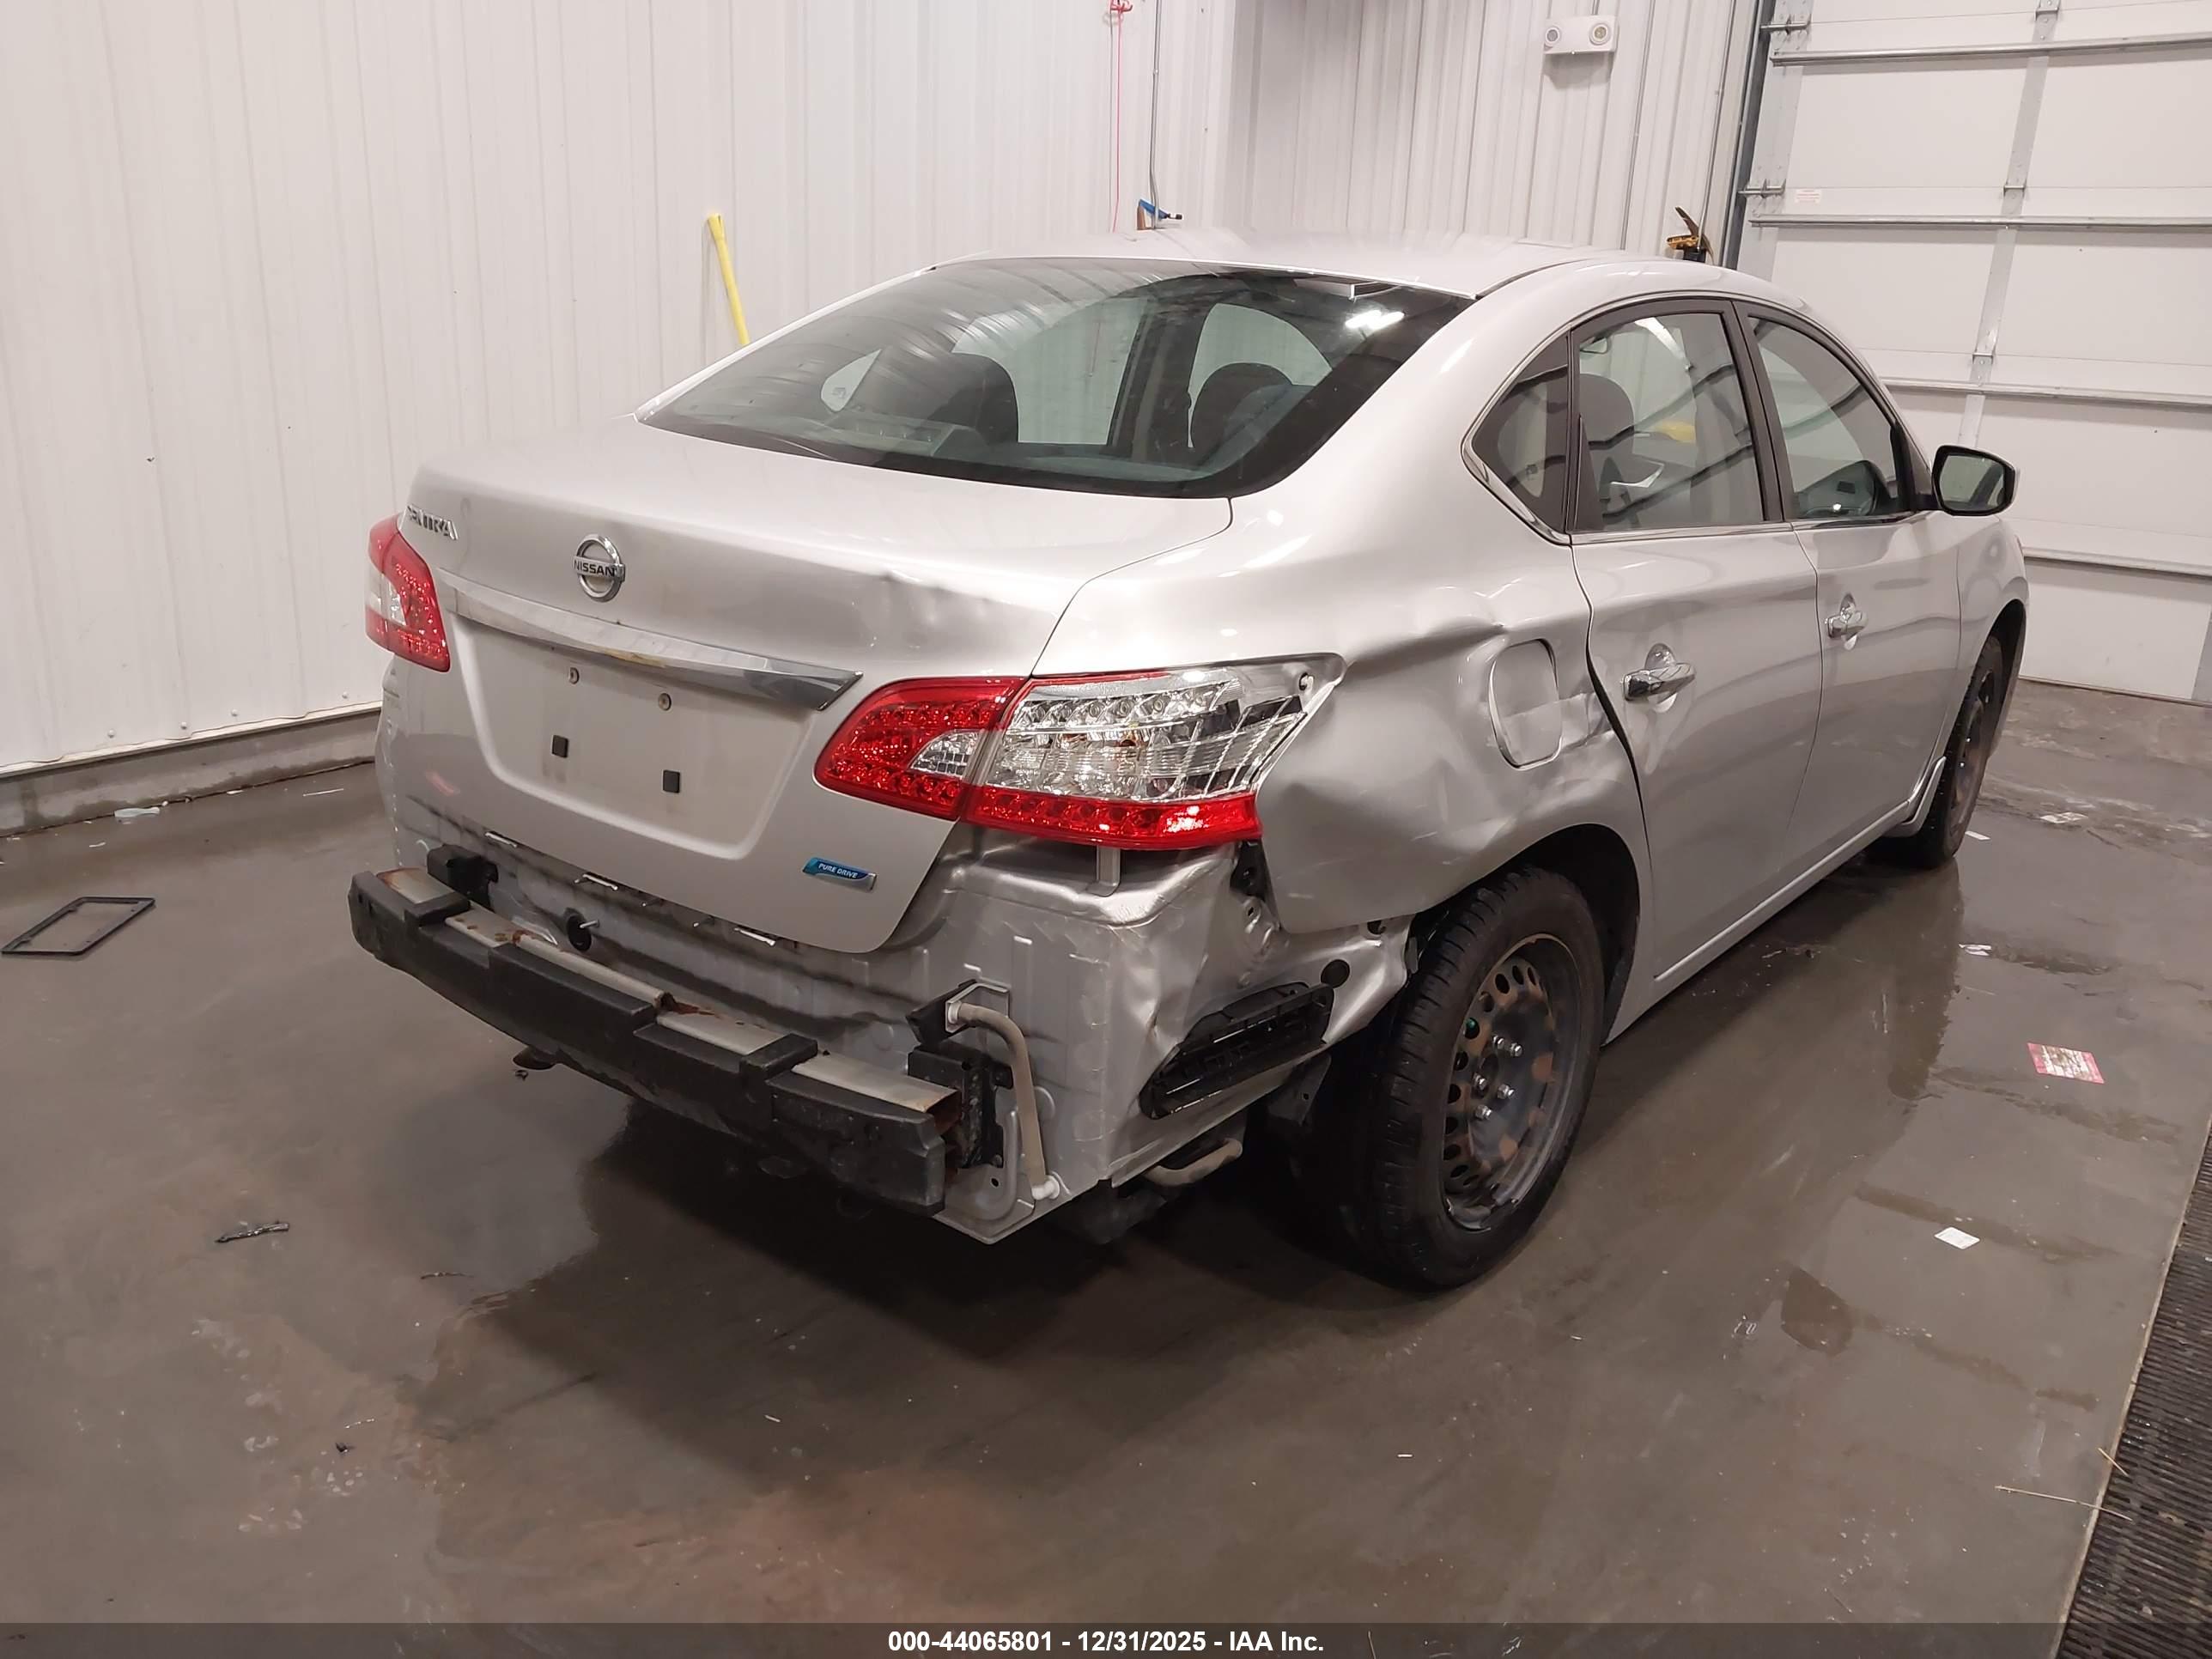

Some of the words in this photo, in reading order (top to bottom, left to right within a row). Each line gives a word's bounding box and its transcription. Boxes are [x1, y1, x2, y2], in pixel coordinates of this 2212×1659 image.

[574, 559, 616, 577] NISSAN
[818, 862, 836, 873] PURE
[836, 867, 859, 878] DRIVE
